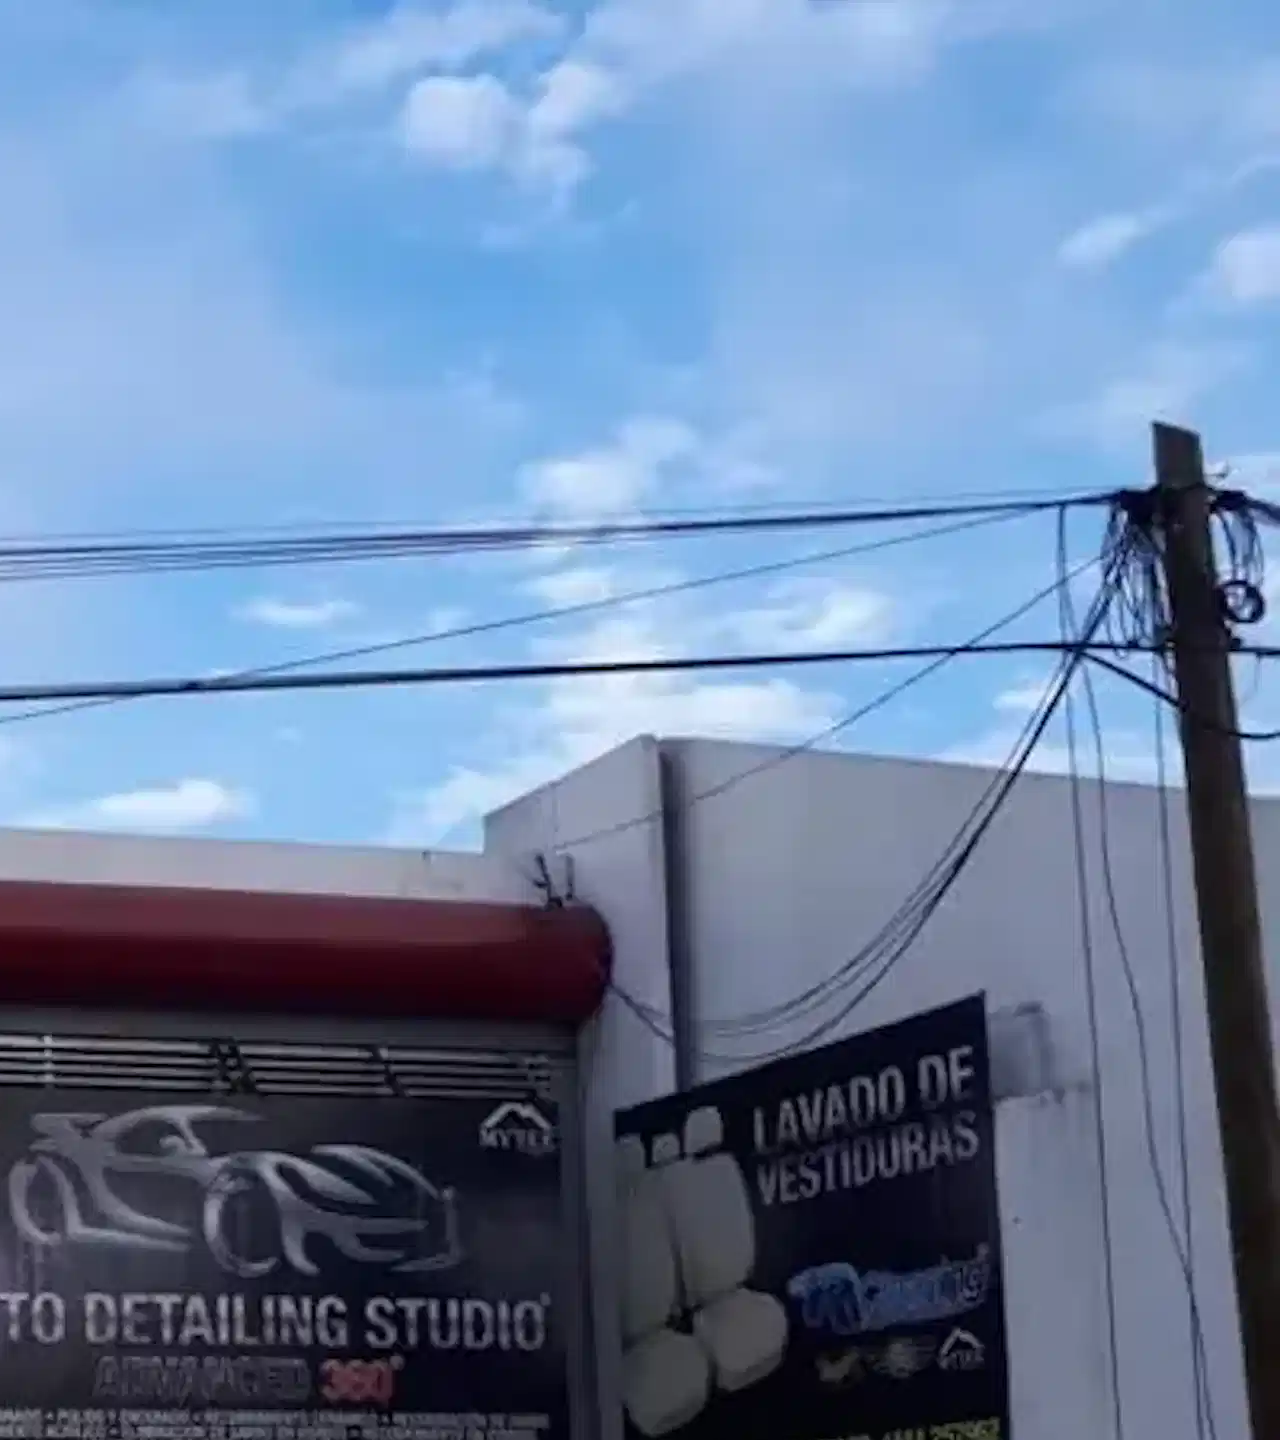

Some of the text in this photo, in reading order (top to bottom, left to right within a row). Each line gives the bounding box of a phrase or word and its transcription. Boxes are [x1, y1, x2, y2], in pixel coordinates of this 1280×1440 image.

[753, 1045, 976, 1151] LAVADO DE
[756, 1109, 981, 1206] VESTIDURAS
[84, 1292, 348, 1348] DETAILING
[362, 1298, 546, 1349] STUDIO
